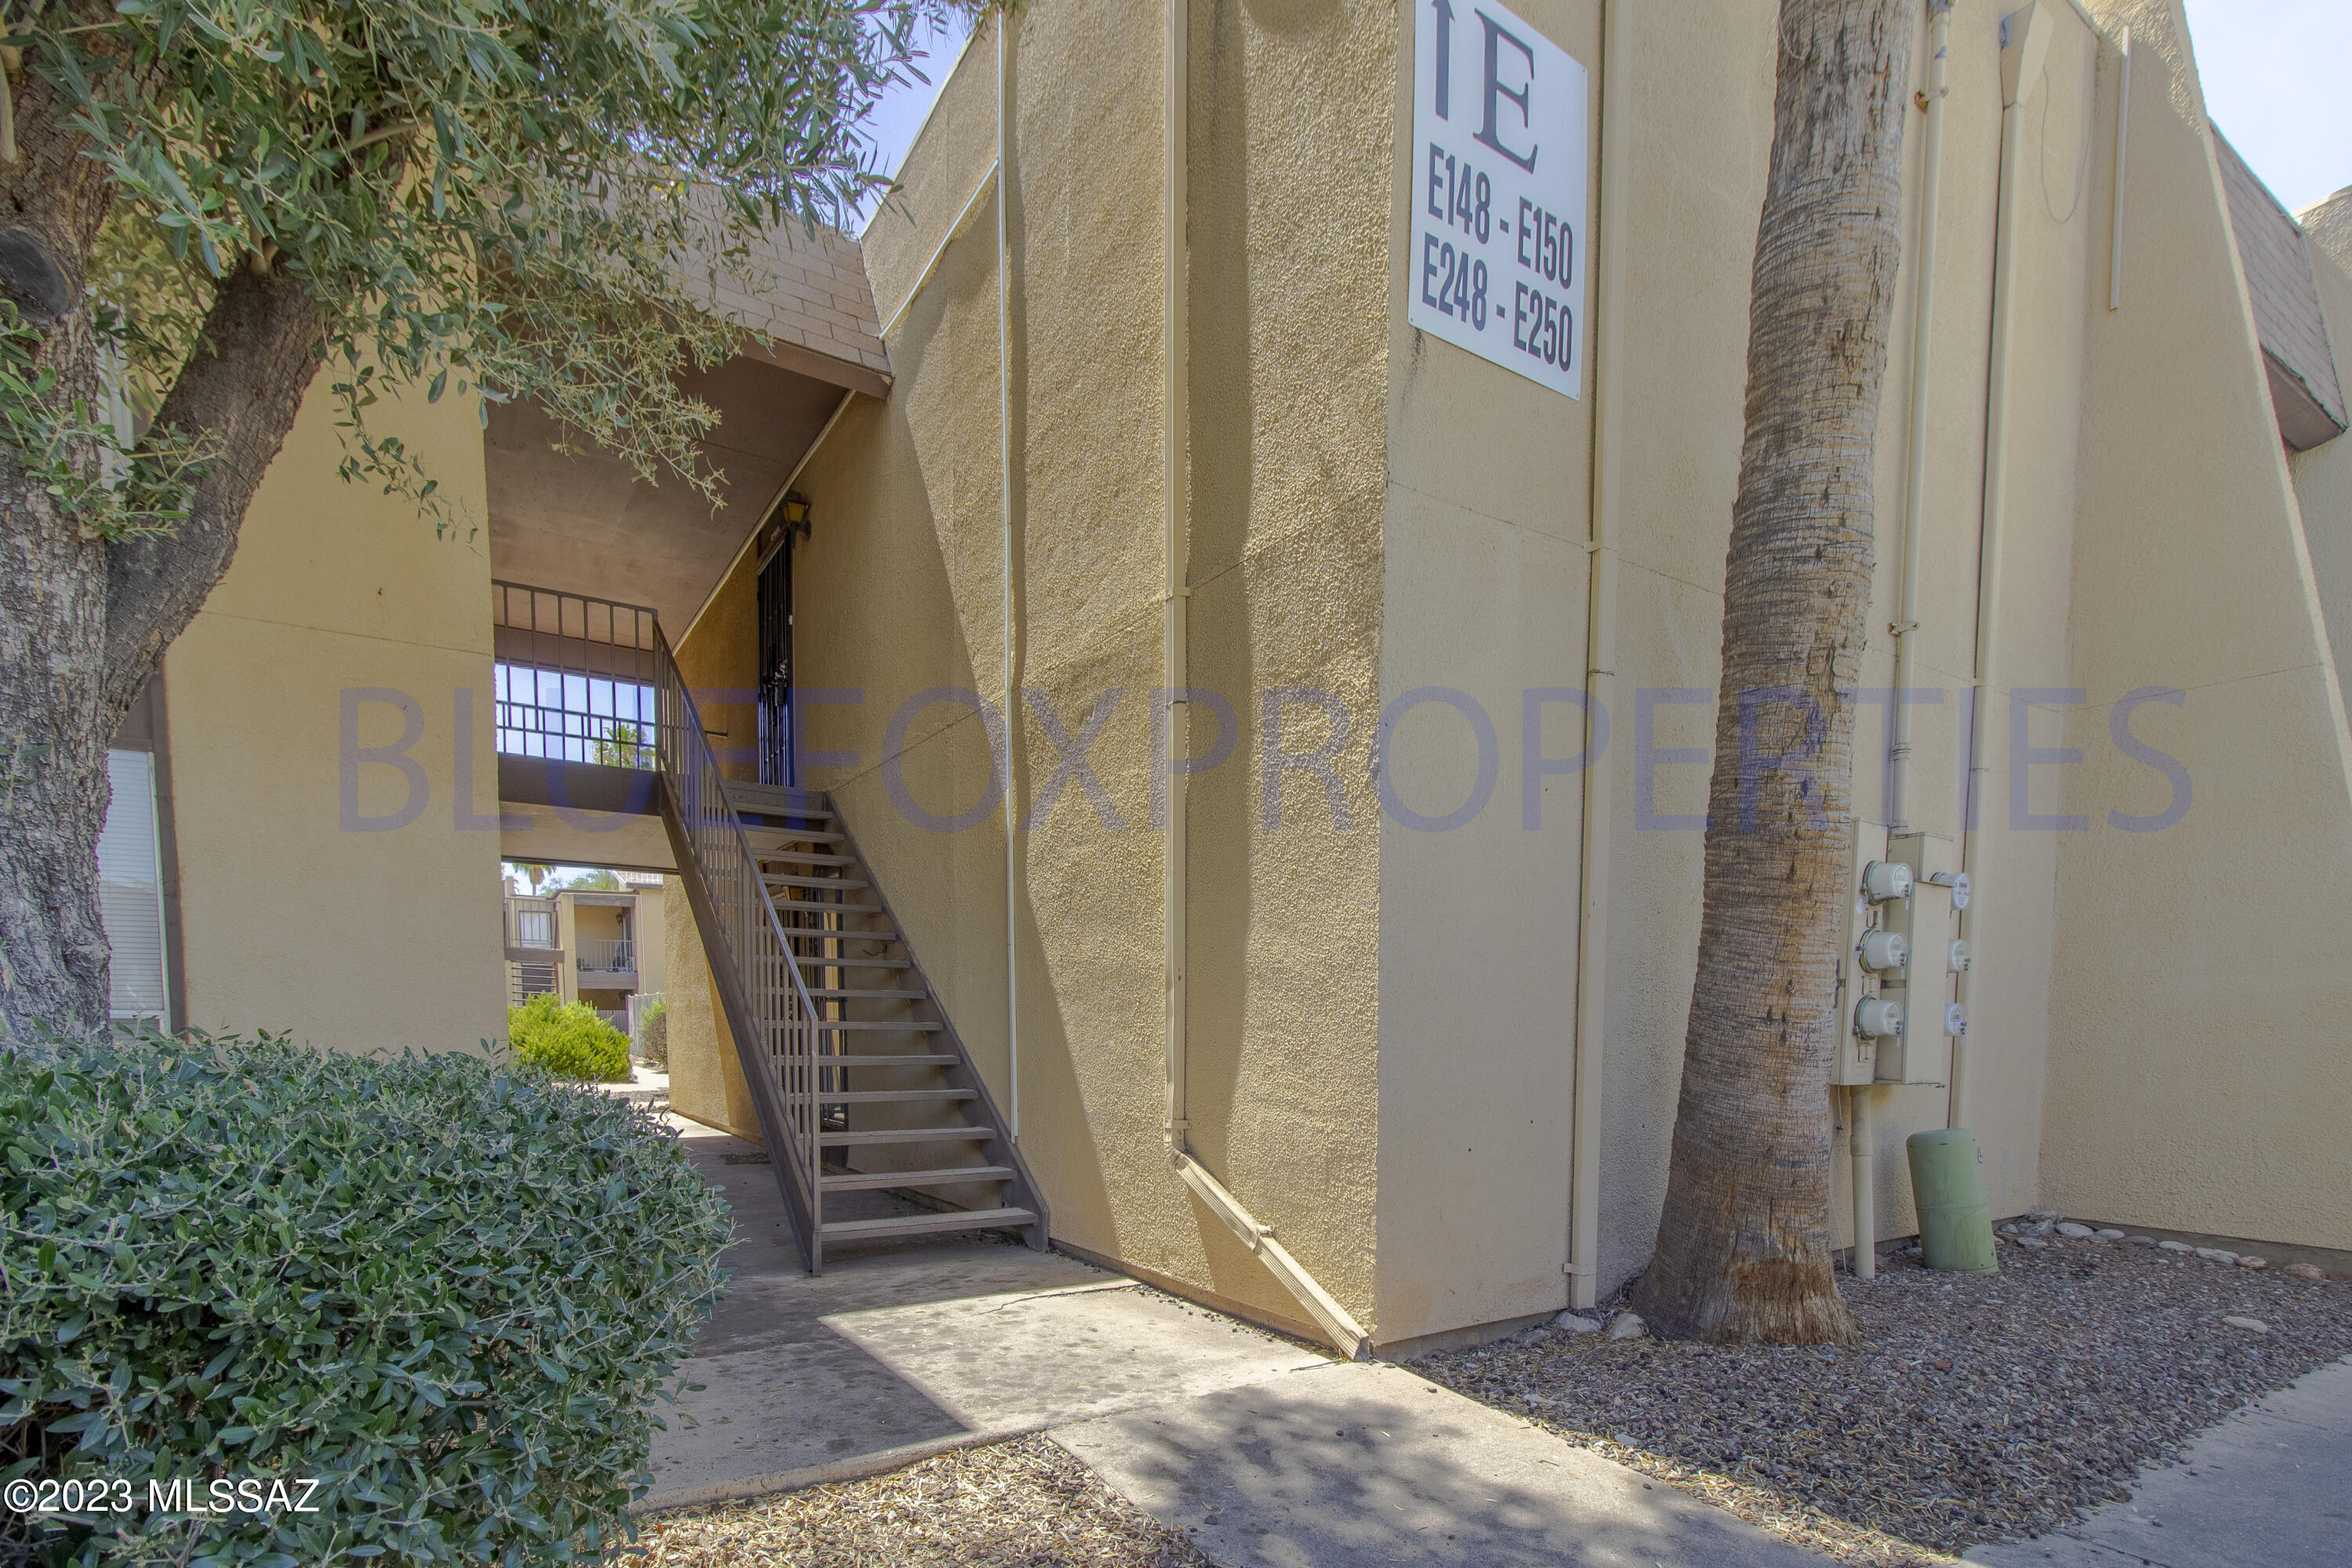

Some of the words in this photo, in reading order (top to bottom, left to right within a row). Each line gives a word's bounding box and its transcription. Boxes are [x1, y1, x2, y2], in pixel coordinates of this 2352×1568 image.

[1473, 8, 1538, 175] E
[1428, 142, 1490, 245] E148
[1517, 195, 1573, 289] E150
[1422, 231, 1488, 332] E248
[1513, 280, 1573, 372] E250
